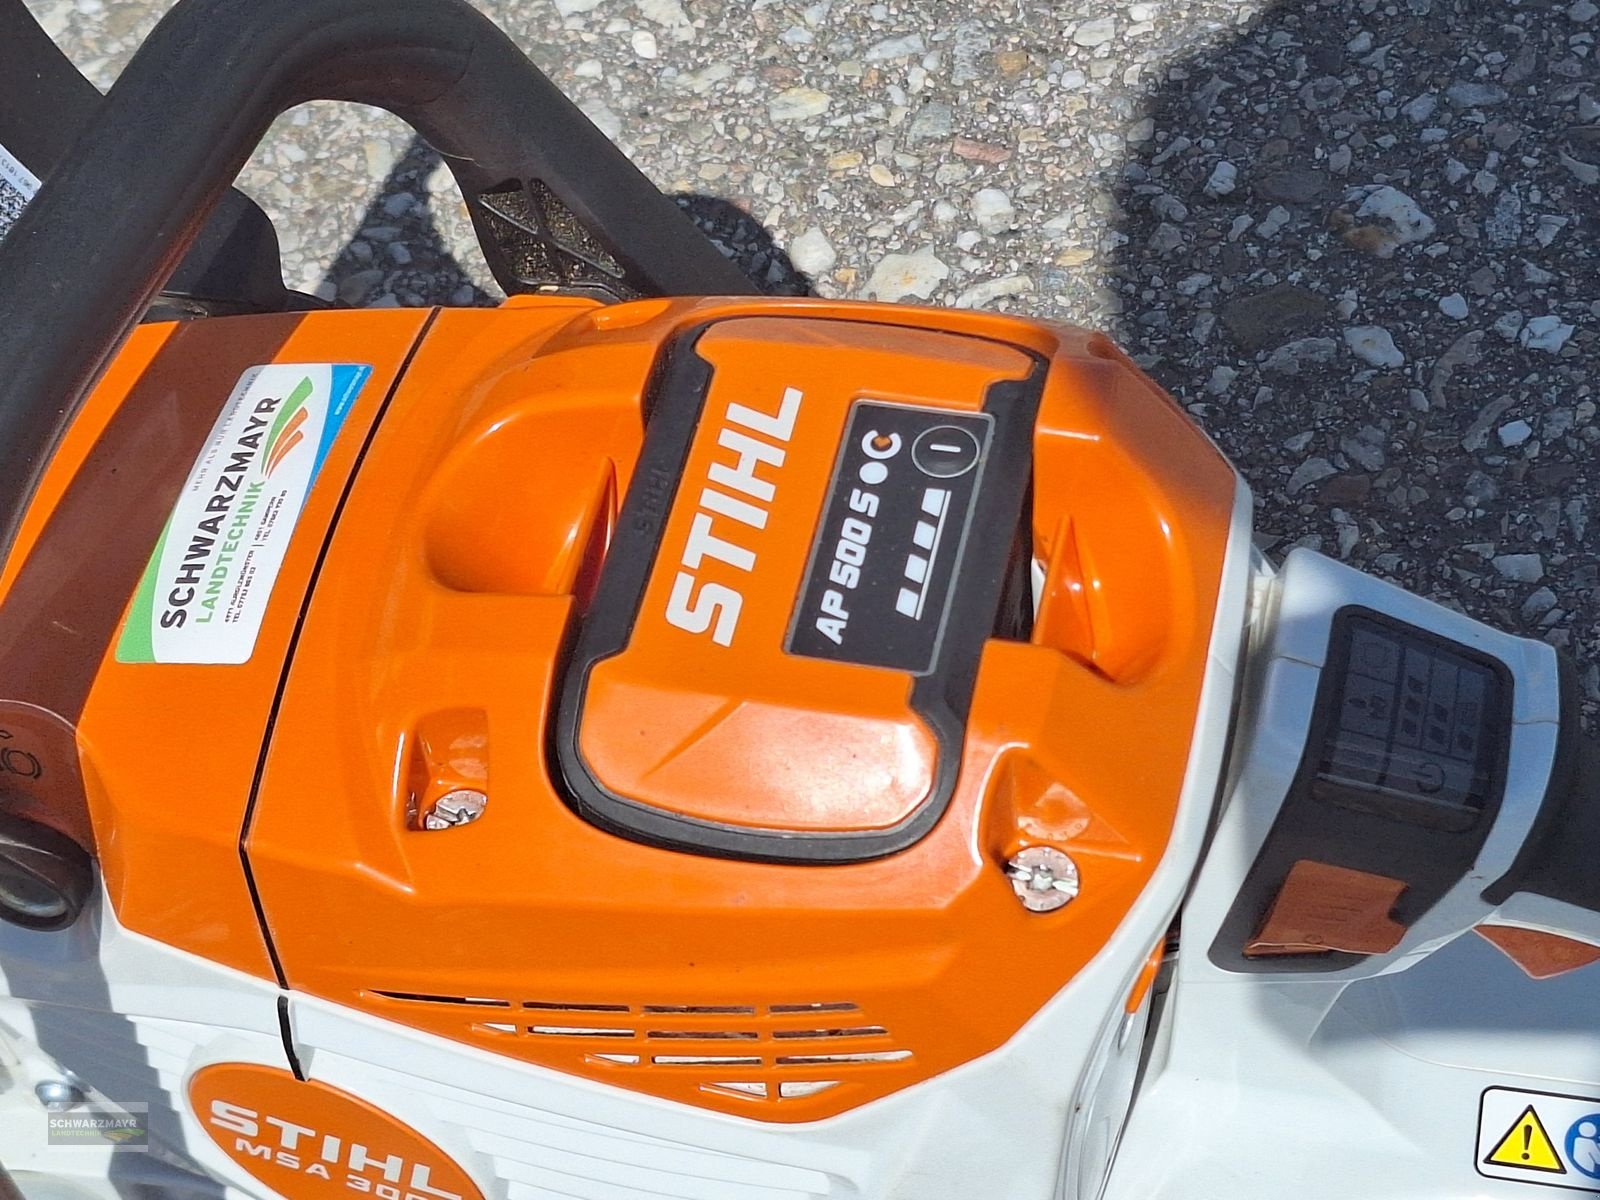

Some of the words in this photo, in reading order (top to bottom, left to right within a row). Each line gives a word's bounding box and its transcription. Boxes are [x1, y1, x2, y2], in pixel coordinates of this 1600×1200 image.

[206, 449, 218, 464] ALS
[160, 398, 282, 628] SCHWARZMAYR
[665, 387, 803, 647] STIHL
[849, 488, 880, 518] S
[195, 480, 265, 623] LANDTECHNIK
[829, 517, 872, 589] 500
[816, 589, 849, 645] AP
[210, 1099, 462, 1200] STIHL
[235, 1137, 331, 1180] MSA
